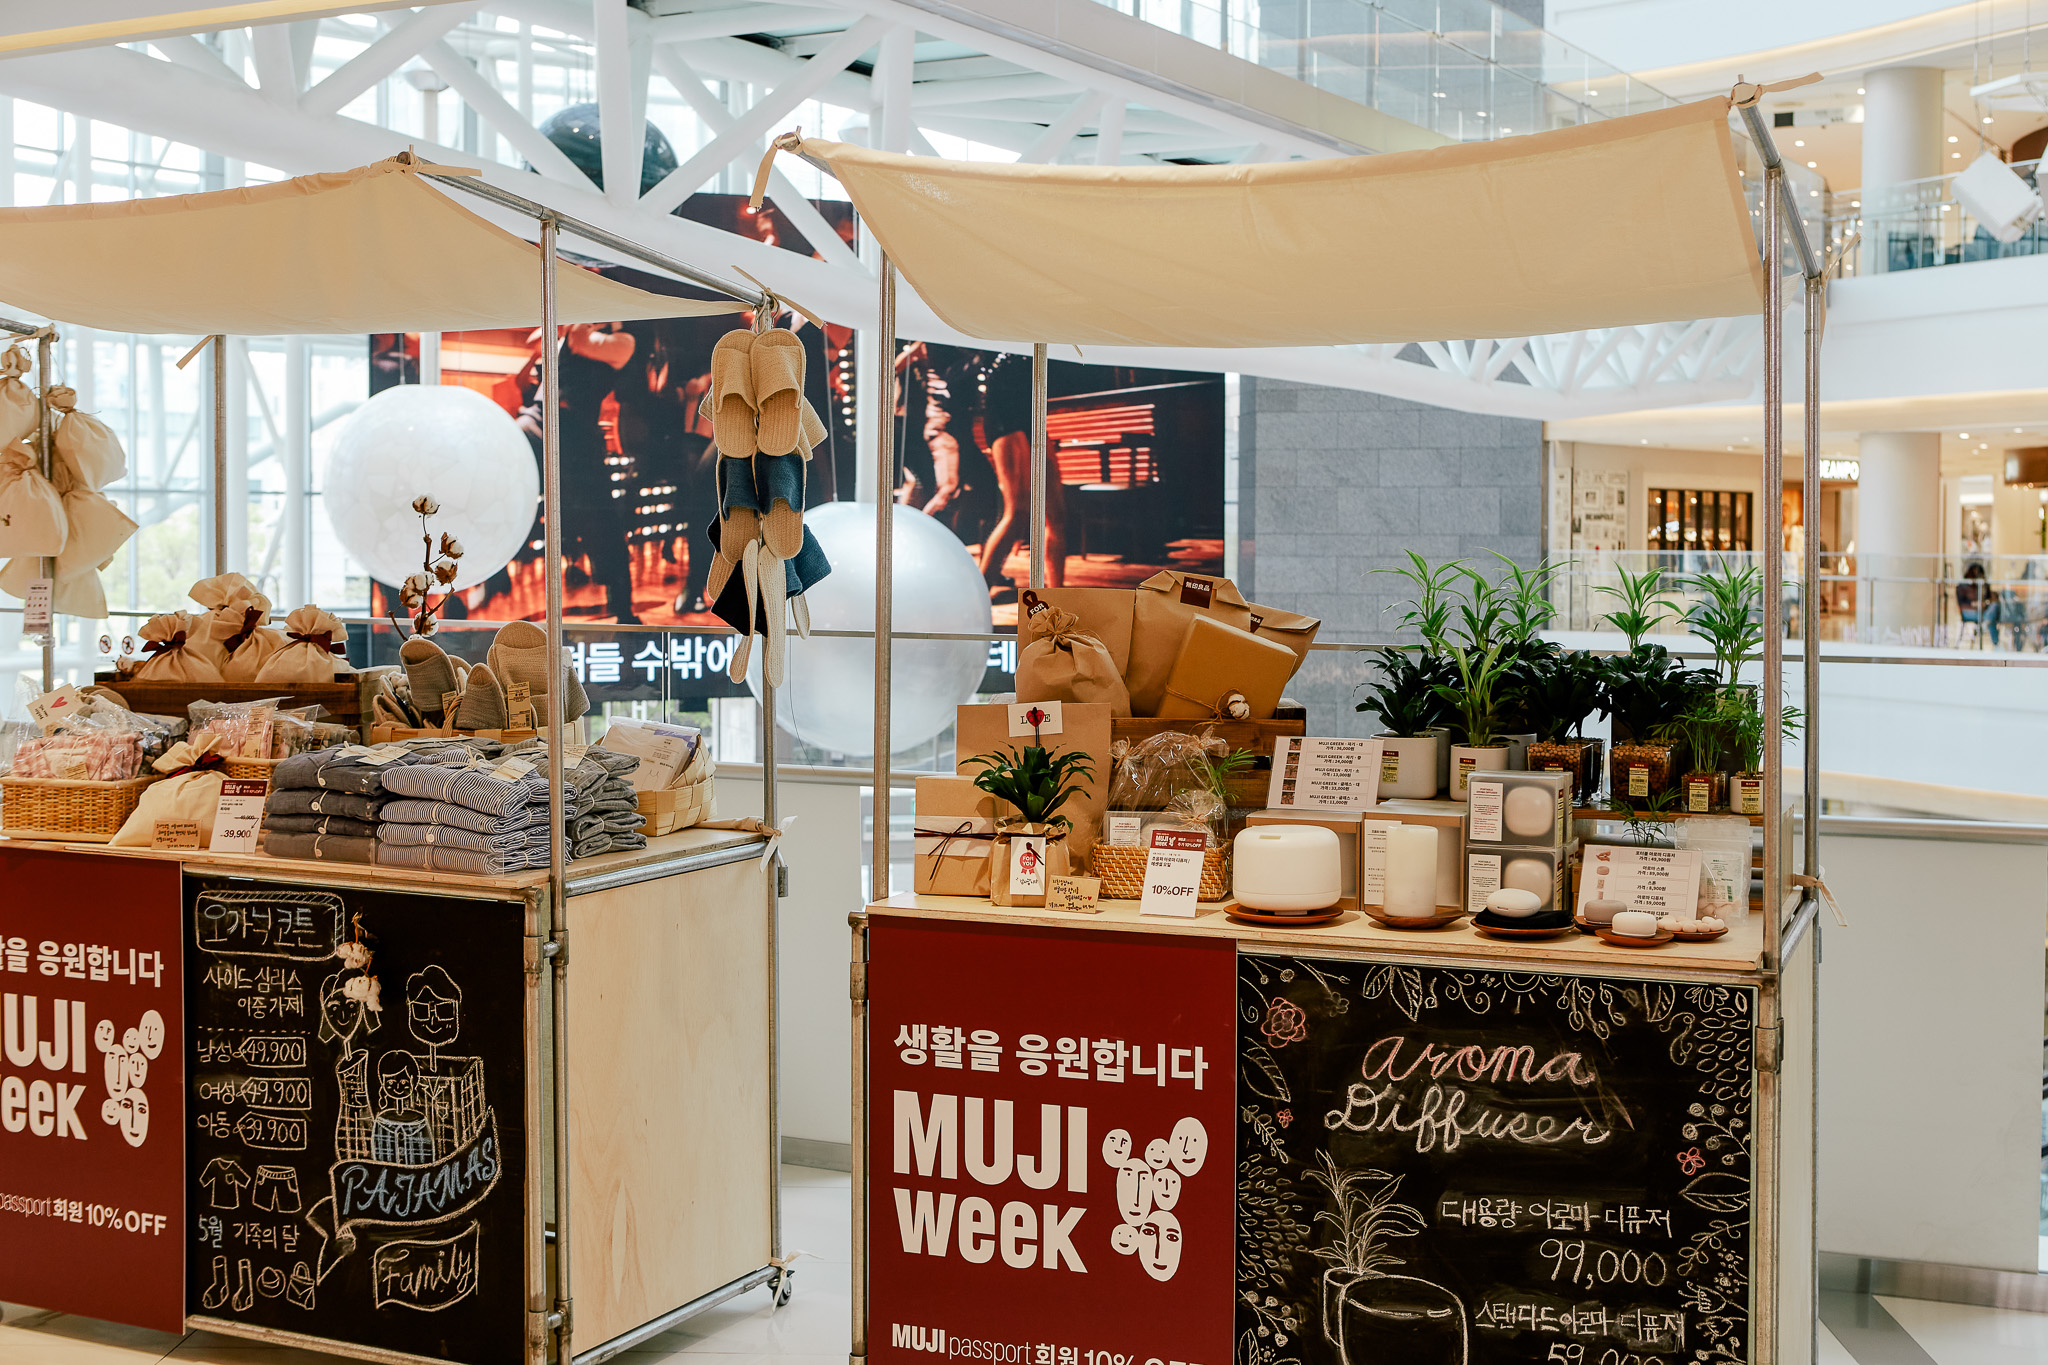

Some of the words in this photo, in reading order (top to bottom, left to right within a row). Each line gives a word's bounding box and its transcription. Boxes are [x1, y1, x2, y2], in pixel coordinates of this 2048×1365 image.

[224, 829, 251, 839] 39,900
[1151, 884, 1194, 897] 10%OFF
[204, 904, 272, 946] 오가닉
[0, 934, 30, 973] 을
[36, 940, 165, 988] 응원합니다
[202, 964, 252, 989] 사이드
[254, 966, 302, 993] 심리스
[237, 996, 267, 1019] 이중
[0, 991, 87, 1074] UJI
[197, 1039, 232, 1063] 남성
[893, 1023, 1003, 1073] 생활을
[1015, 1033, 1209, 1091] 응원합니다
[0, 1074, 88, 1141] eek
[200, 1080, 235, 1104] 여성
[197, 1111, 231, 1138] 아동
[1324, 1082, 1611, 1153] Diffuser
[893, 1089, 1088, 1194] MUJI
[341, 1137, 497, 1217] PAJAMAS
[52, 1197, 84, 1224] 회원
[1441, 1197, 1523, 1229] 대용량
[1528, 1198, 1600, 1232] 아로마
[1604, 1205, 1673, 1239] 디퓨저
[199, 1214, 223, 1249] 5월
[232, 1222, 278, 1249] 가족의
[282, 1223, 300, 1253] 달
[378, 1243, 472, 1300] Family
[1539, 1239, 1668, 1290] 99,000
[1559, 1305, 1615, 1337] 아로마
[892, 1322, 946, 1354] MUJI
[949, 1335, 1032, 1365] passport
